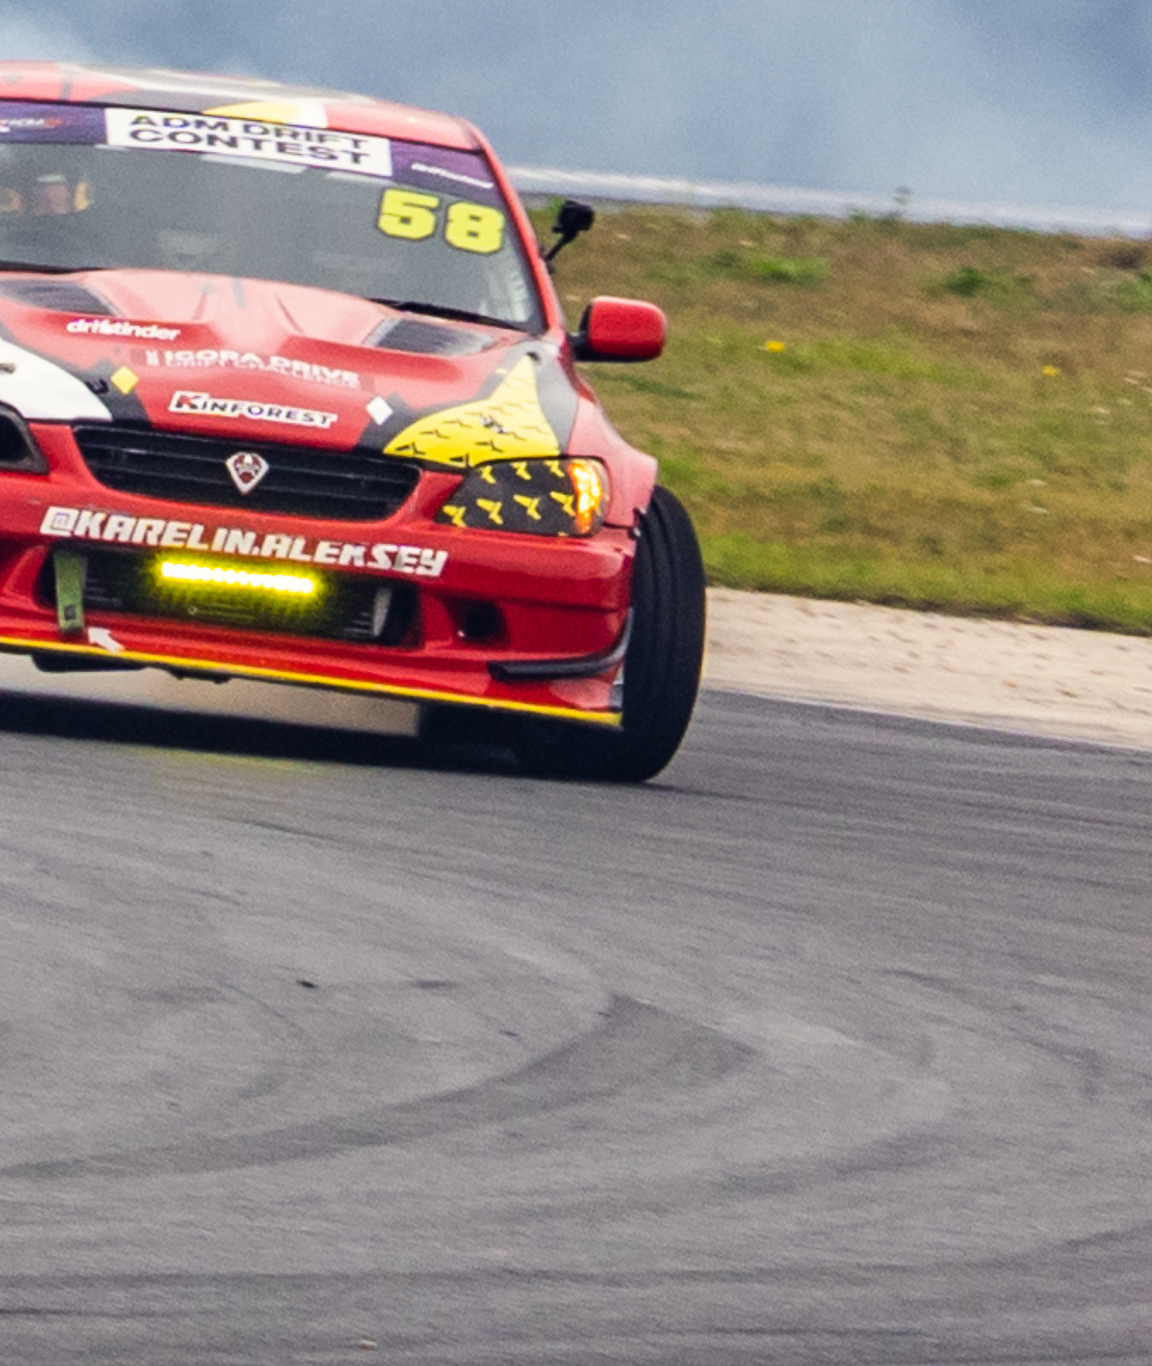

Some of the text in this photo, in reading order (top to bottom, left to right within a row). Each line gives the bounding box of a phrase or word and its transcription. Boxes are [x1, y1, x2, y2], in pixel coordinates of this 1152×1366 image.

[129, 128, 371, 166] CONTEST
[131, 114, 368, 149] ADM DRIFT
[378, 187, 506, 254] 58
[165, 348, 360, 385] IGORA DRIVE
[174, 392, 332, 426] KINFOREST
[38, 504, 449, 578] @KARELIN.ALEKSEY
